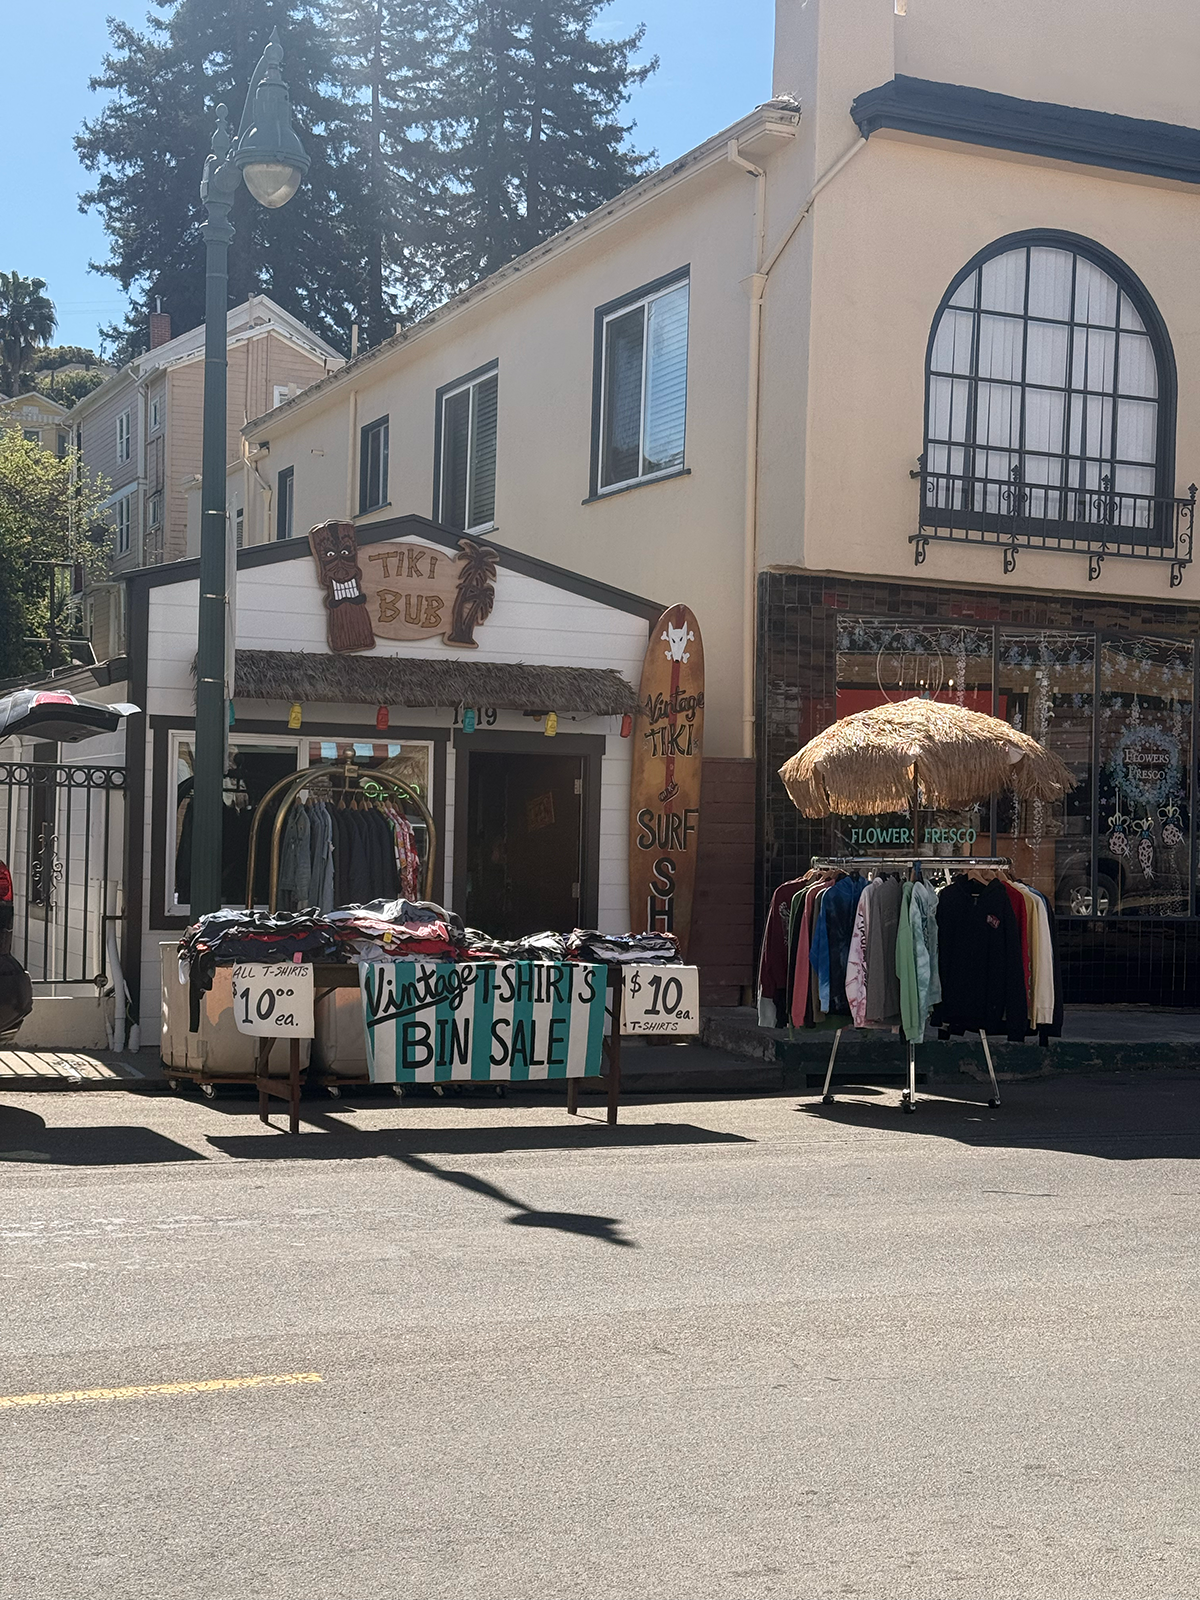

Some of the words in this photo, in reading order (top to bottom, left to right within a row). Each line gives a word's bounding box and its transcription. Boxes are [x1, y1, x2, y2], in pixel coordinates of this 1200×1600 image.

[368, 548, 438, 579] TIKI
[377, 589, 445, 628] BUB
[453, 703, 497, 726] 119
[645, 686, 705, 725] Vintage
[644, 724, 694, 758] TIKI
[637, 808, 699, 851] SURF
[924, 828, 977, 844] FRESCO
[232, 966, 256, 979] ALL
[262, 965, 309, 977] T-SHIRTS
[365, 964, 479, 1017] Vintage
[476, 963, 597, 1004] T-SHIRT'S
[275, 1013, 299, 1026] ea.
[630, 1021, 679, 1032] T-SHIRTS
[402, 1018, 470, 1069] BIN
[489, 1018, 566, 1067] SALE
